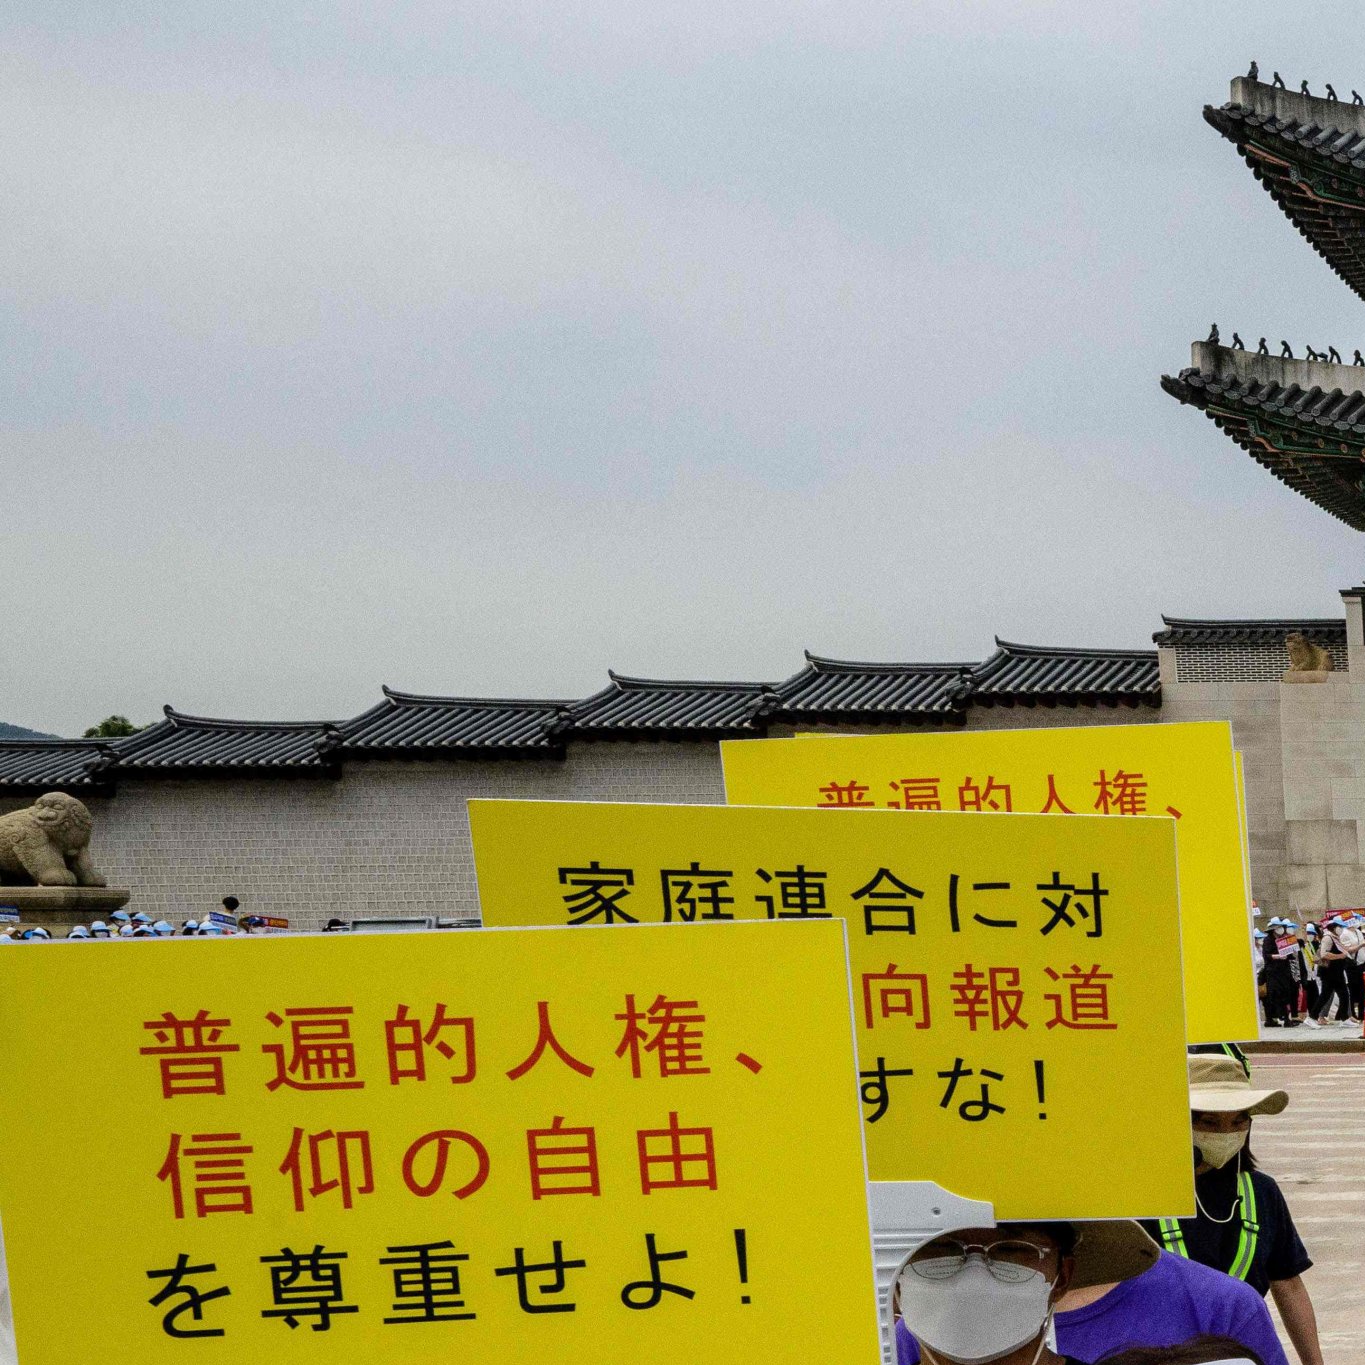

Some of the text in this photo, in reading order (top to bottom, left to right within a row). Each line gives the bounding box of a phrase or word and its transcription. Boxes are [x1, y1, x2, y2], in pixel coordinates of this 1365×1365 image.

[556, 862, 1110, 939] 家庭連合に対
[140, 993, 764, 1100] 普遍的人権、
[156, 1111, 720, 1219] 信仰の自由
[146, 1228, 753, 1339] を尊重せよ!
